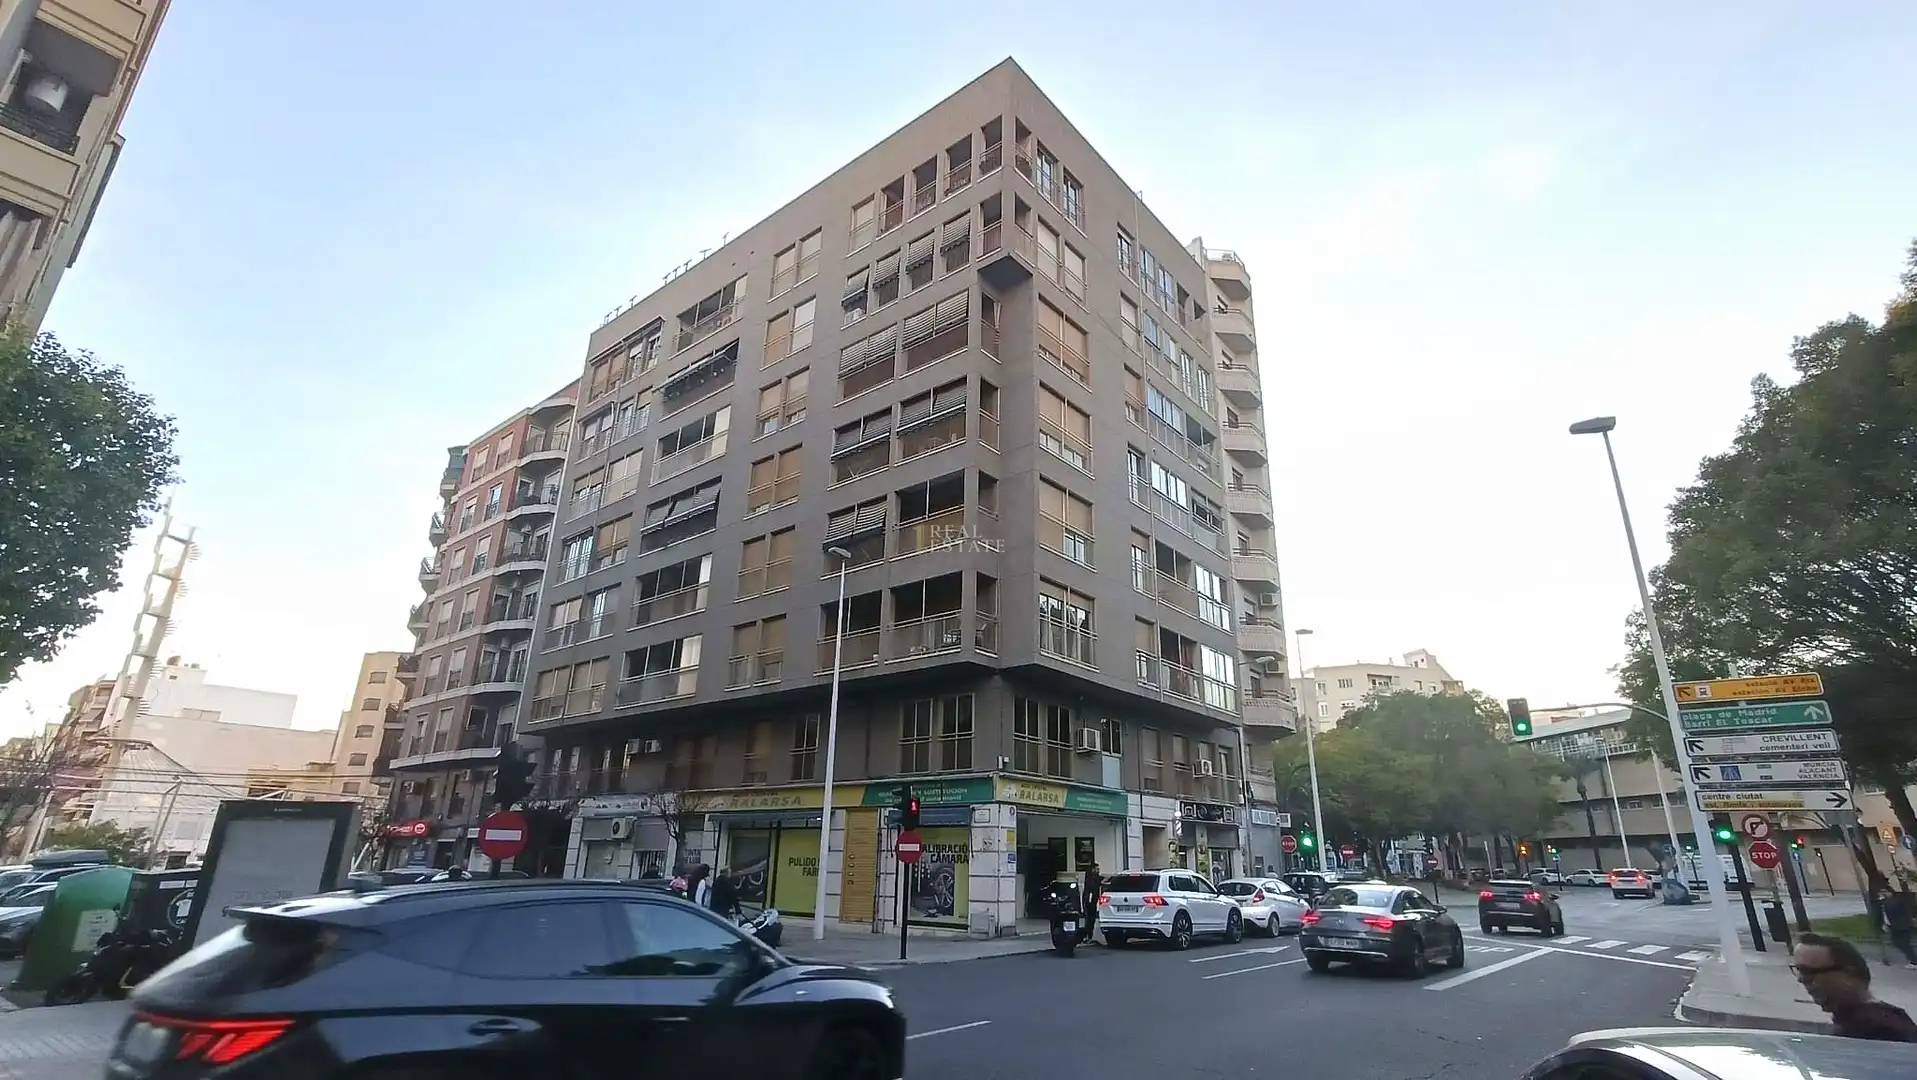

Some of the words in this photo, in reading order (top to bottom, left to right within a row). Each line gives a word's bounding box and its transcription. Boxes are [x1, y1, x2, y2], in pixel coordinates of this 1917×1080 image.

[1718, 710, 1732, 718] de
[1738, 707, 1777, 717] Madrid
[1733, 716, 1773, 726] Toscar
[1762, 733, 1828, 743] CREVILLENT
[1019, 790, 1060, 804] RALARSA
[1702, 792, 1731, 800] centre
[1736, 792, 1764, 800] ciutat
[729, 795, 801, 809] RALARSA
[922, 842, 969, 853] ALIBRACIÓ
[1751, 851, 1777, 860] STOP
[788, 856, 816, 867] PULIDO
